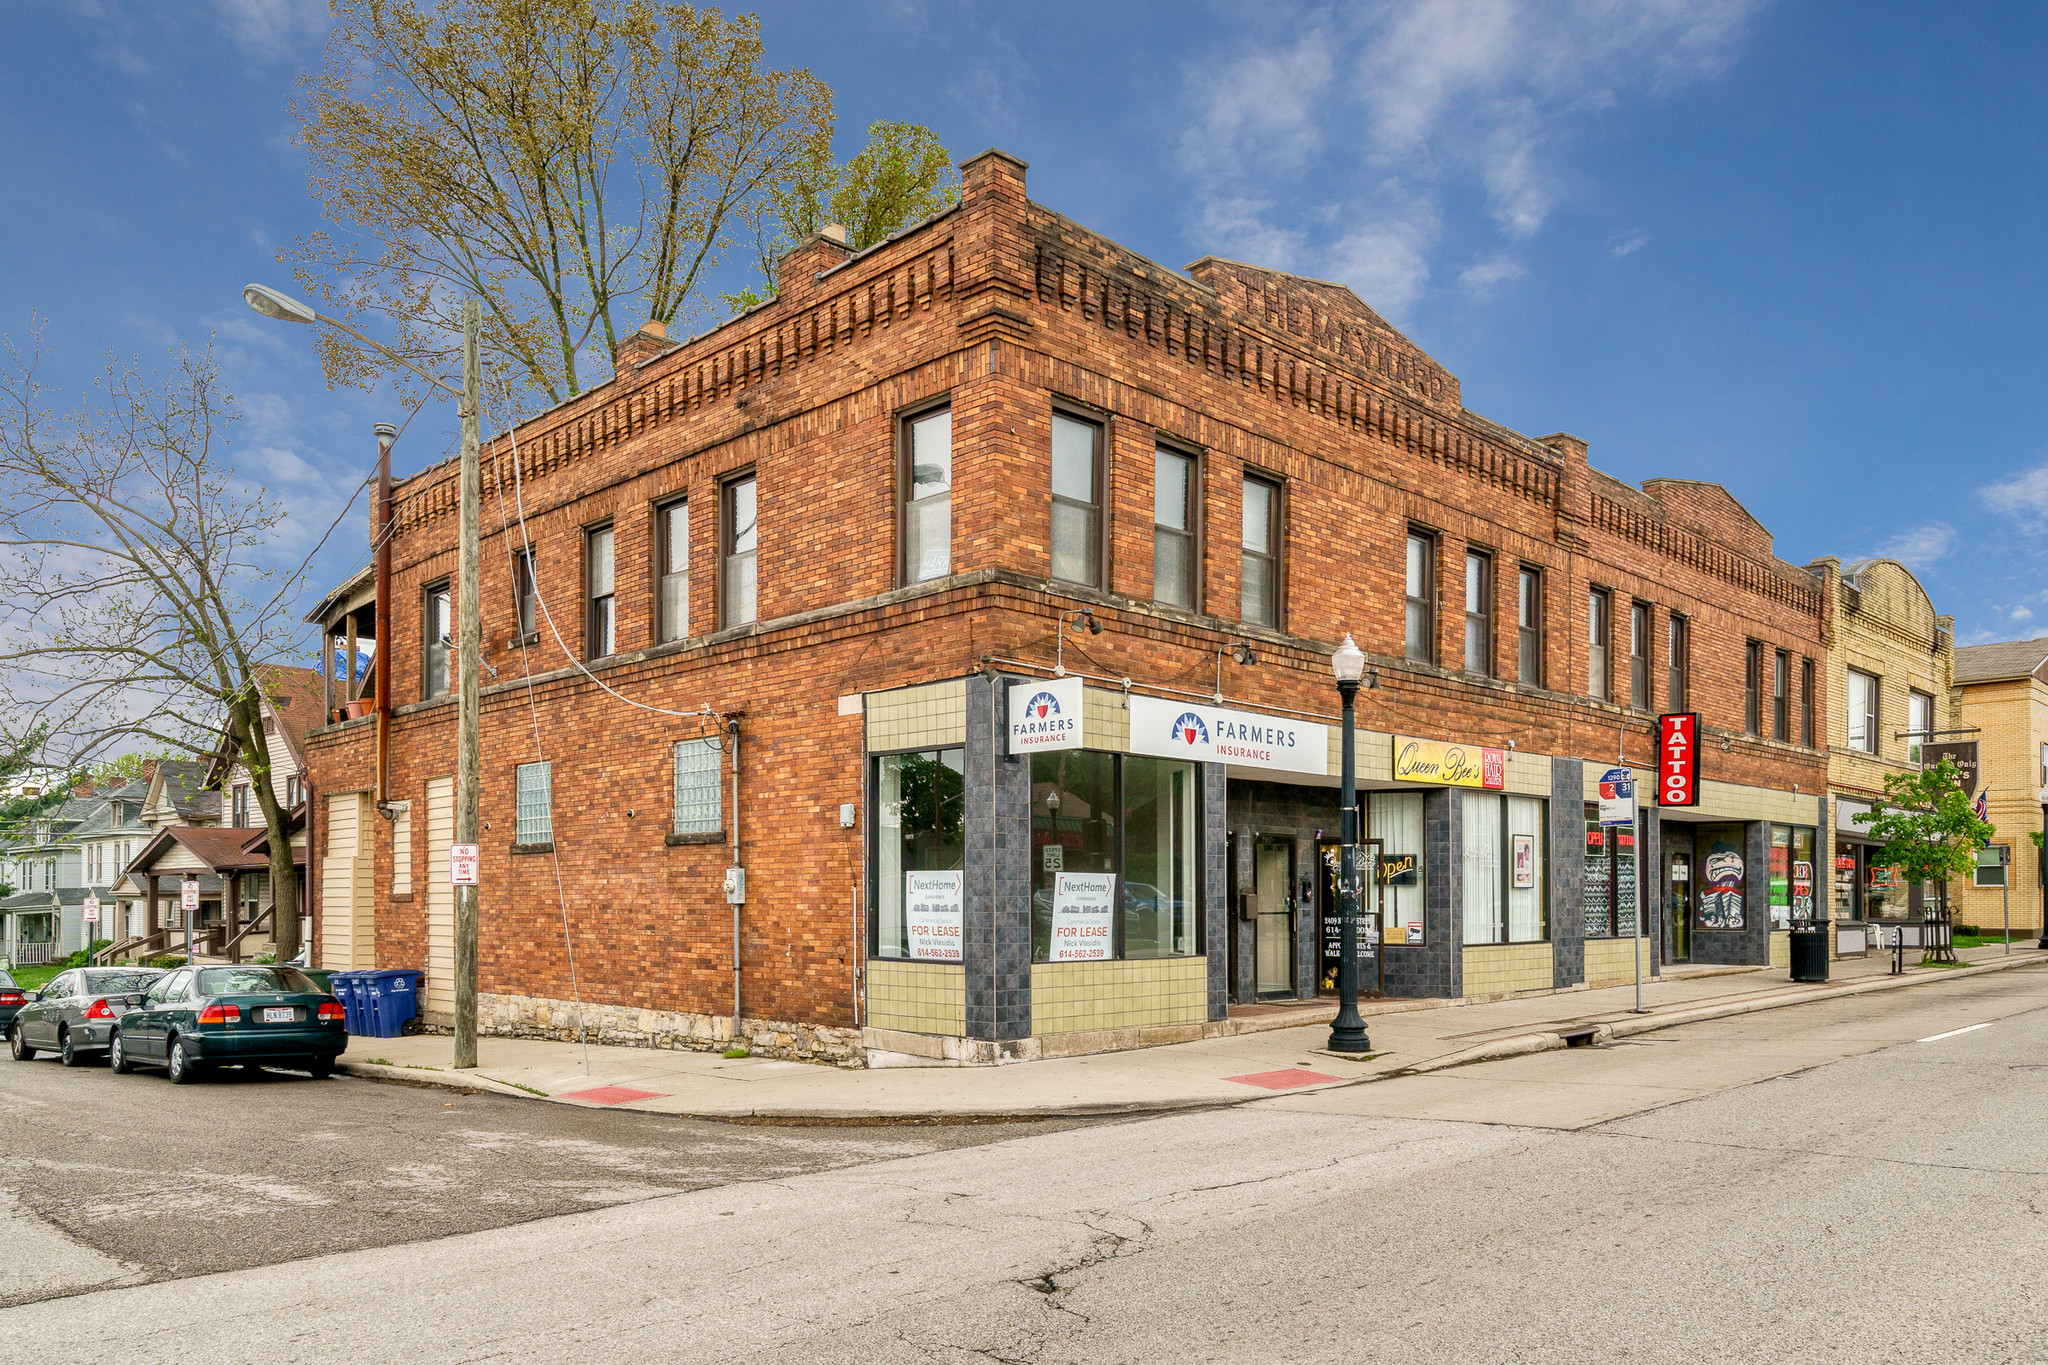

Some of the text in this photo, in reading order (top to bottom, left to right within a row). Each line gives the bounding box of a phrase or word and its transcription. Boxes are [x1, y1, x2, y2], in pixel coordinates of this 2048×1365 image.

[1236, 271, 1303, 338] THE
[1013, 718, 1074, 736] FARMERS
[1020, 733, 1066, 745] INSURANCE
[1216, 720, 1295, 747] FARMERS
[1216, 744, 1271, 761] INSURANCE
[1397, 741, 1480, 781] Queen Bee's
[1666, 717, 1688, 803] TATTOO
[1484, 763, 1502, 778] HAIR
[1608, 782, 1631, 792] 2 31
[1587, 831, 1604, 846] OPEN
[452, 855, 476, 863] STOPPING
[913, 879, 956, 890] NextHome
[1064, 881, 1107, 892] NextHome
[911, 925, 960, 937] FOR LEASE
[1057, 926, 1108, 938] FOR LEASE
[919, 938, 932, 946] Nick
[917, 948, 960, 958] 614-562-2539
[1059, 949, 1105, 958] 614-562-2539
[266, 1012, 278, 1020] HLN
